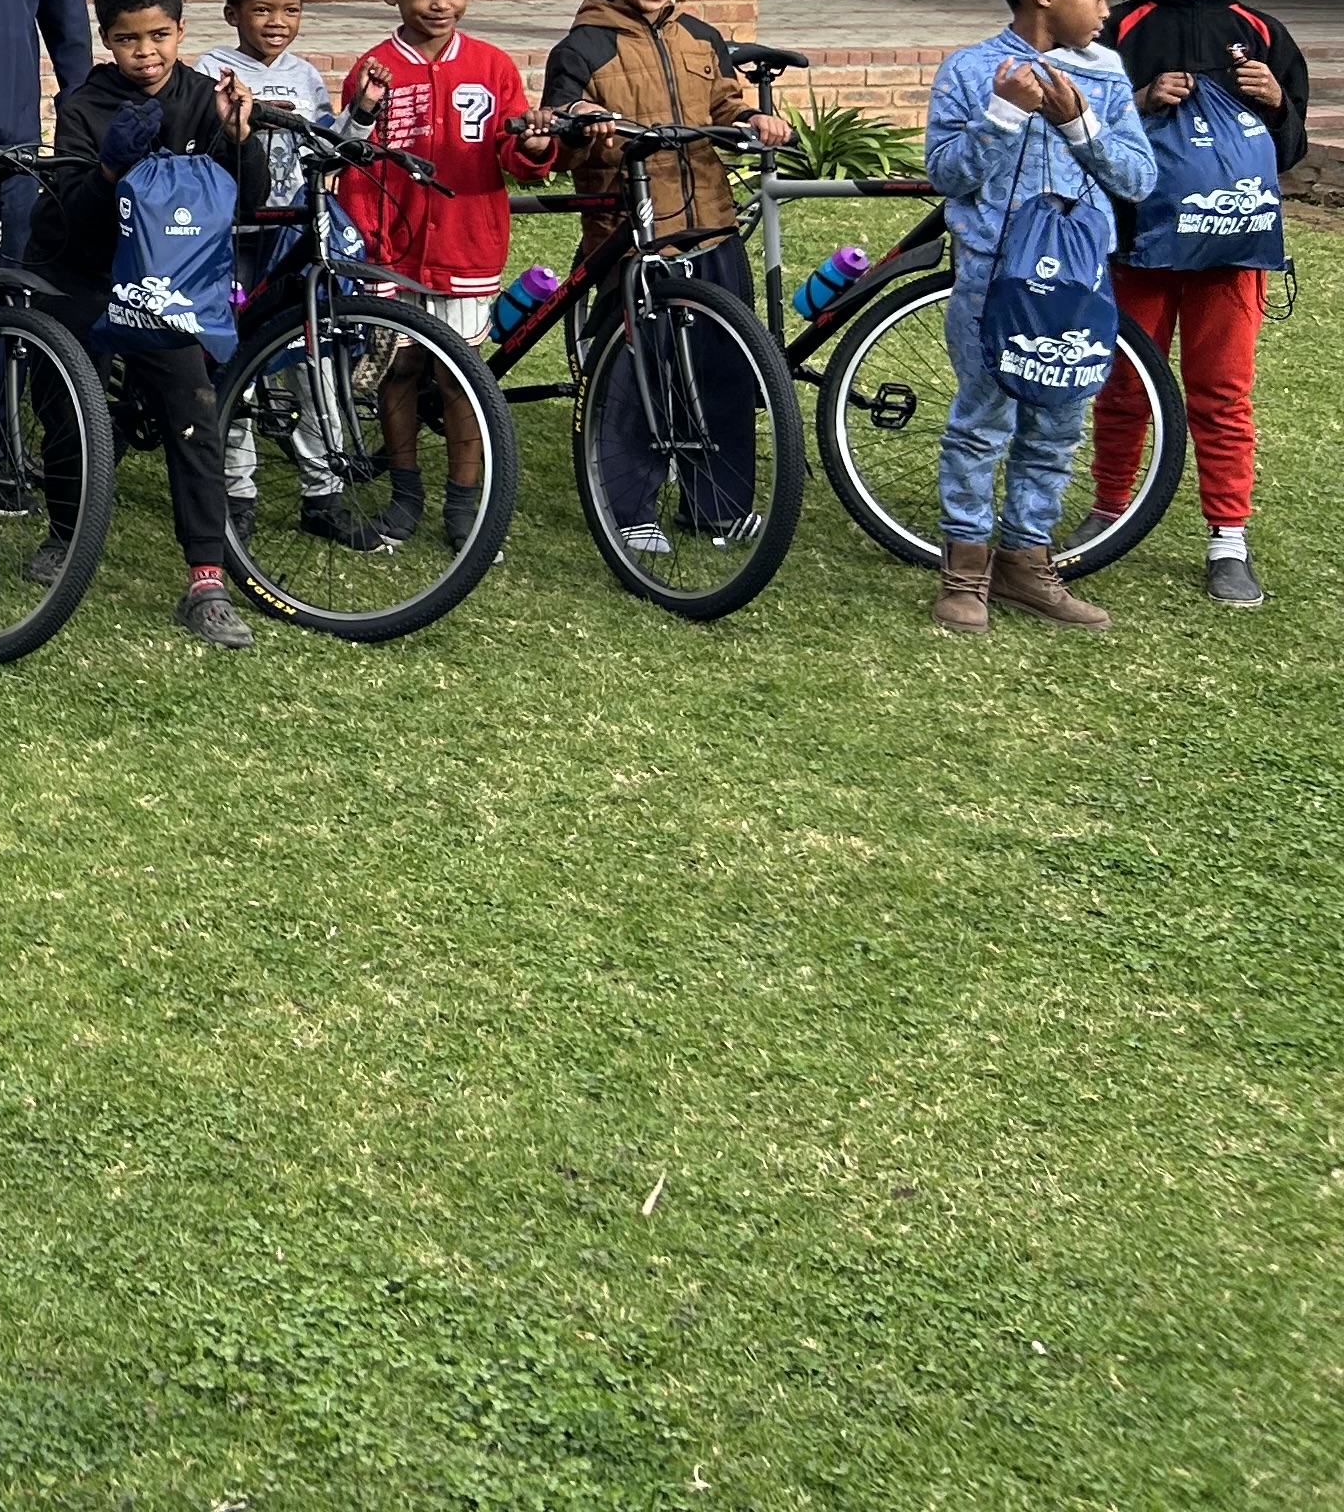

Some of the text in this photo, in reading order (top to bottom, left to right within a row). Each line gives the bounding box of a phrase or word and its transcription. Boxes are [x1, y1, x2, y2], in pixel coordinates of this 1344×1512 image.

[165, 226, 202, 236] LIBERTY
[1200, 211, 1277, 235] CYCLE TOUR
[124, 307, 205, 334] CYCLE TOUR
[1023, 358, 1073, 387] CYCLE
[574, 375, 588, 433] KENDA
[246, 577, 298, 616] KENDA
